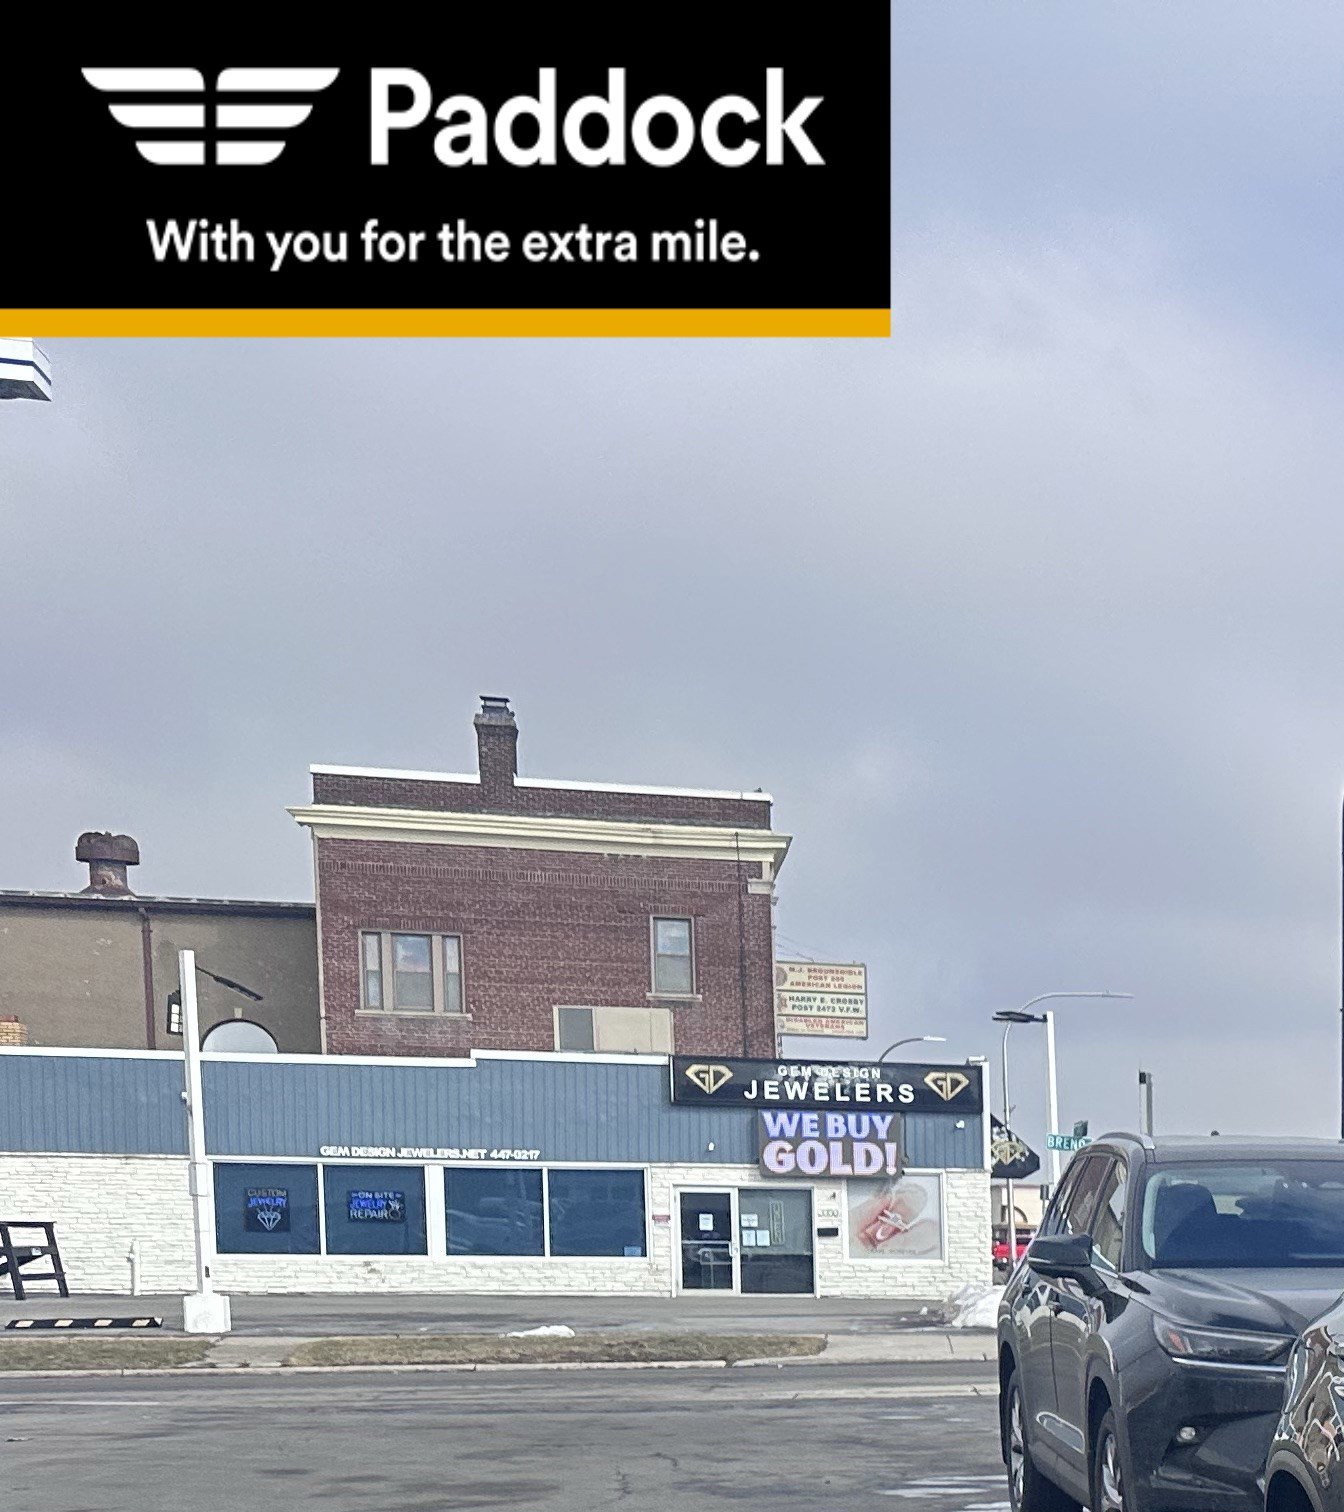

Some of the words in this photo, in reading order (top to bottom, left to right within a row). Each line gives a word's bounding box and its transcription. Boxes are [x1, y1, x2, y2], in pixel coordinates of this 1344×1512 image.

[789, 996, 817, 1004] HARRY
[778, 1065, 812, 1077] GEM
[743, 1080, 915, 1103] JEWELERS
[762, 1111, 820, 1138] WE
[826, 1113, 894, 1139] BUY
[319, 1146, 351, 1157] GEM
[351, 1146, 396, 1158] DESIGN
[763, 1140, 897, 1175] GOLD!
[350, 1209, 388, 1219] REPAIR
